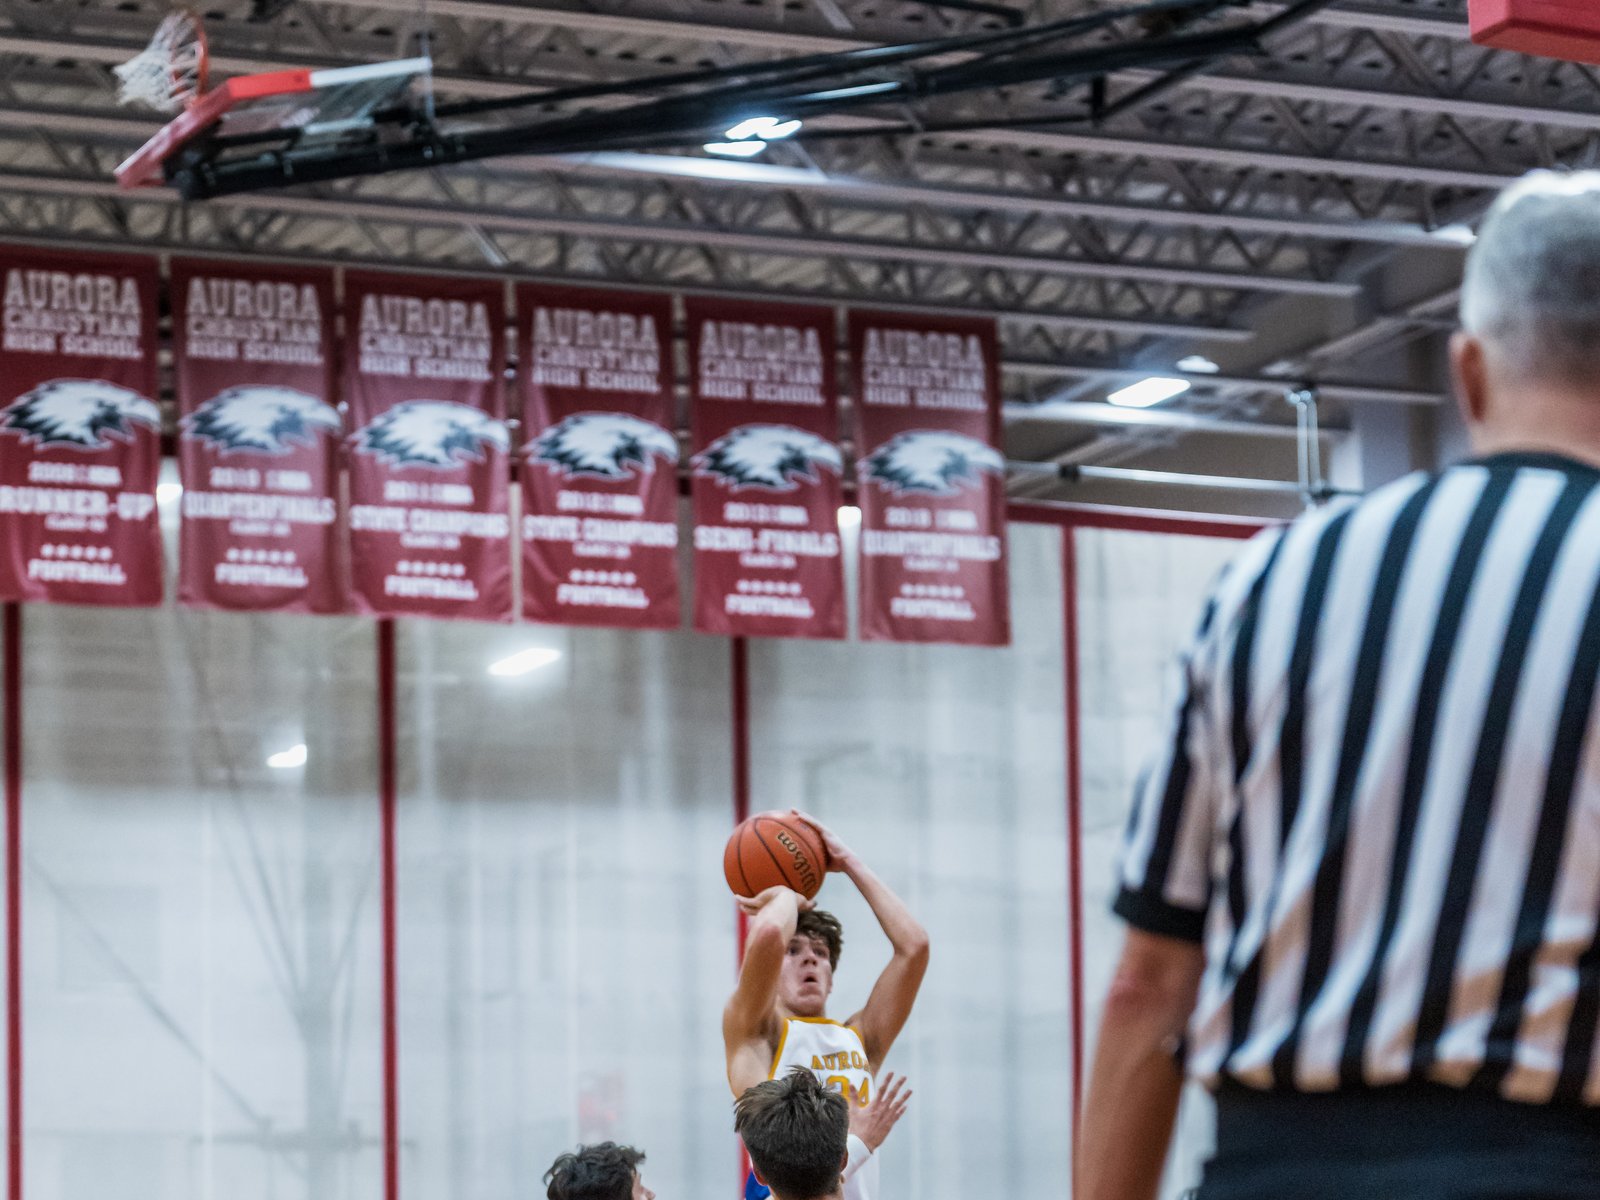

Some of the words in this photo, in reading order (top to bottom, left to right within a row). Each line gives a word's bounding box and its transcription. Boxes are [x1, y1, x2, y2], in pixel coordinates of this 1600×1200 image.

[4, 268, 141, 314] AURORA
[186, 276, 322, 321] AURORA
[360, 293, 491, 338] AURORA
[532, 307, 658, 350] AURORA
[700, 320, 823, 364] AURORA
[863, 327, 985, 371] AURORA
